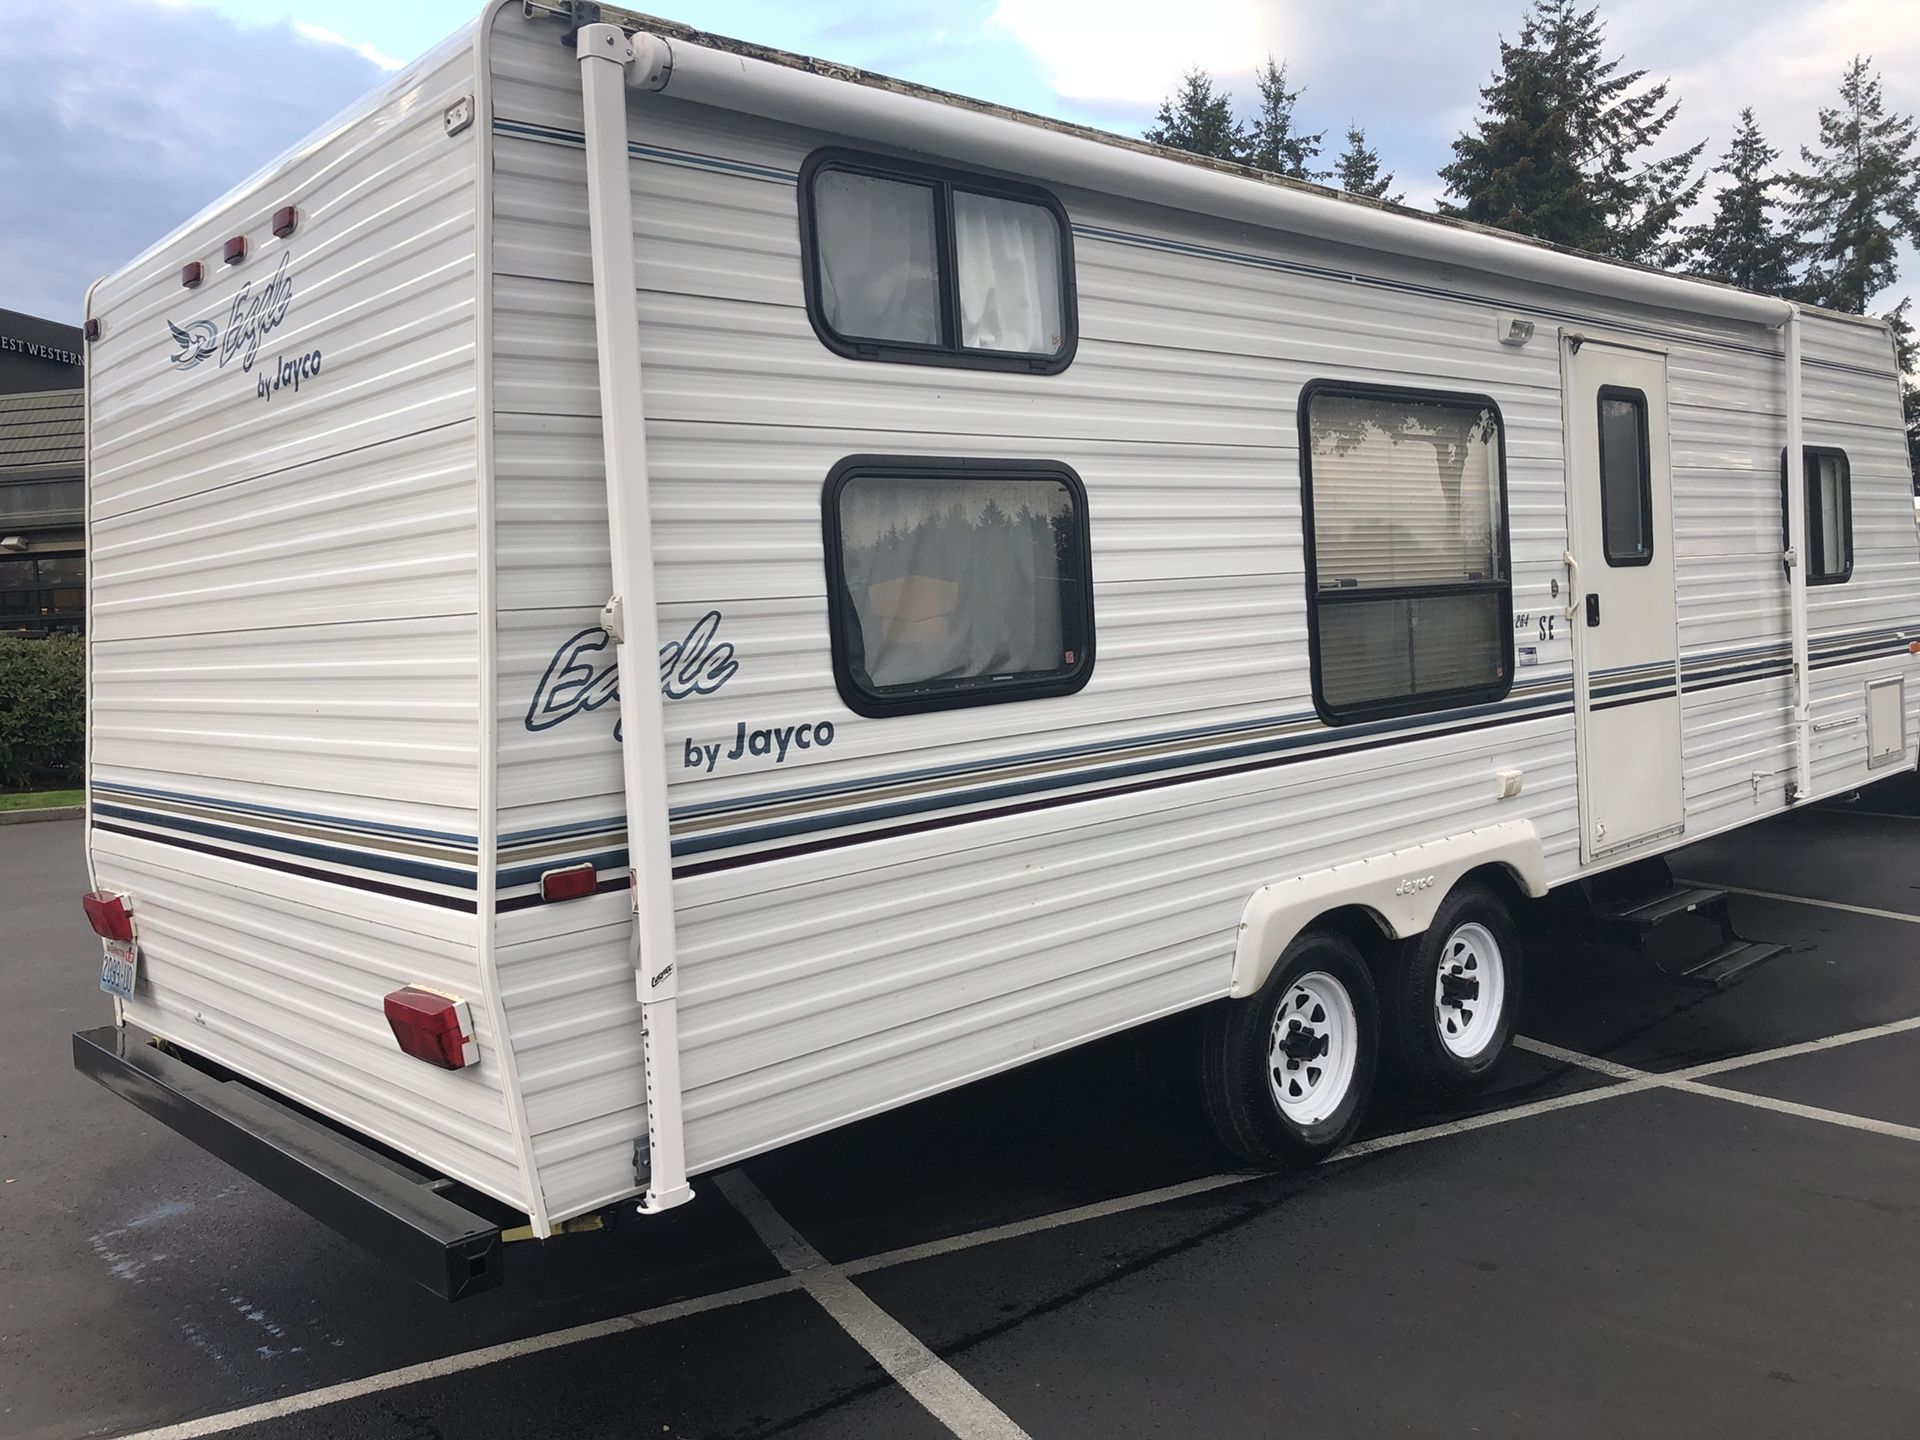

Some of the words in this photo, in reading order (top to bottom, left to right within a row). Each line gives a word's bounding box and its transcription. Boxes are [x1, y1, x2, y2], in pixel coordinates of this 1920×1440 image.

[219, 250, 292, 373] Eagle
[257, 372, 272, 402] by
[273, 350, 322, 392] Jayco
[1539, 615, 1555, 641] SE
[684, 738, 721, 773] by
[727, 721, 835, 763] Jayco
